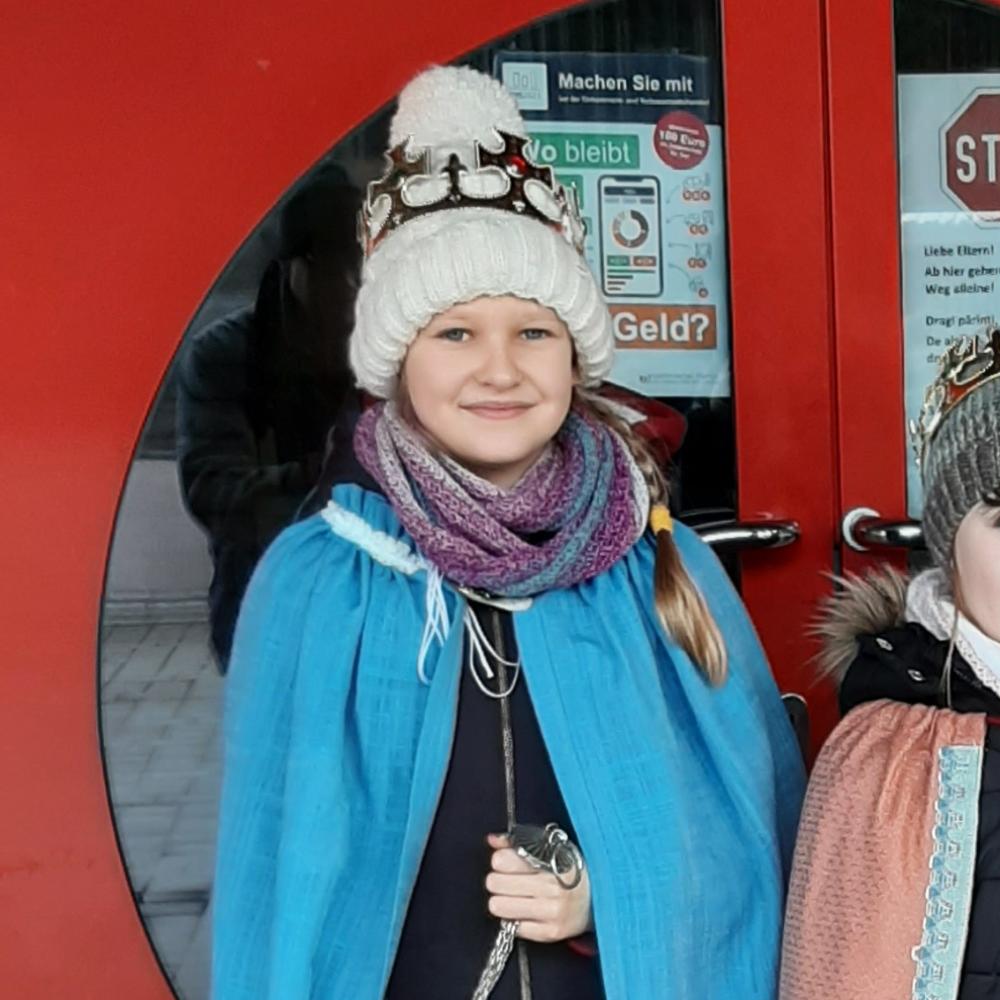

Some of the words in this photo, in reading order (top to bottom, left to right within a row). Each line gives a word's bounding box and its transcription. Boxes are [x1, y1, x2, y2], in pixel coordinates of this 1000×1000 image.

[558, 72, 627, 91] Machen
[632, 74, 660, 91] Sie
[665, 76, 693, 92] mit
[680, 133, 706, 148] Euro
[565, 140, 631, 165] bleibt
[924, 245, 953, 257] Liebe
[957, 244, 994, 257] Eltern!
[925, 265, 940, 277] Ab
[943, 265, 964, 277] hier
[925, 283, 950, 296] Weg
[953, 281, 994, 294] alleine!
[613, 311, 709, 342] Geld?
[926, 335, 941, 347] De
